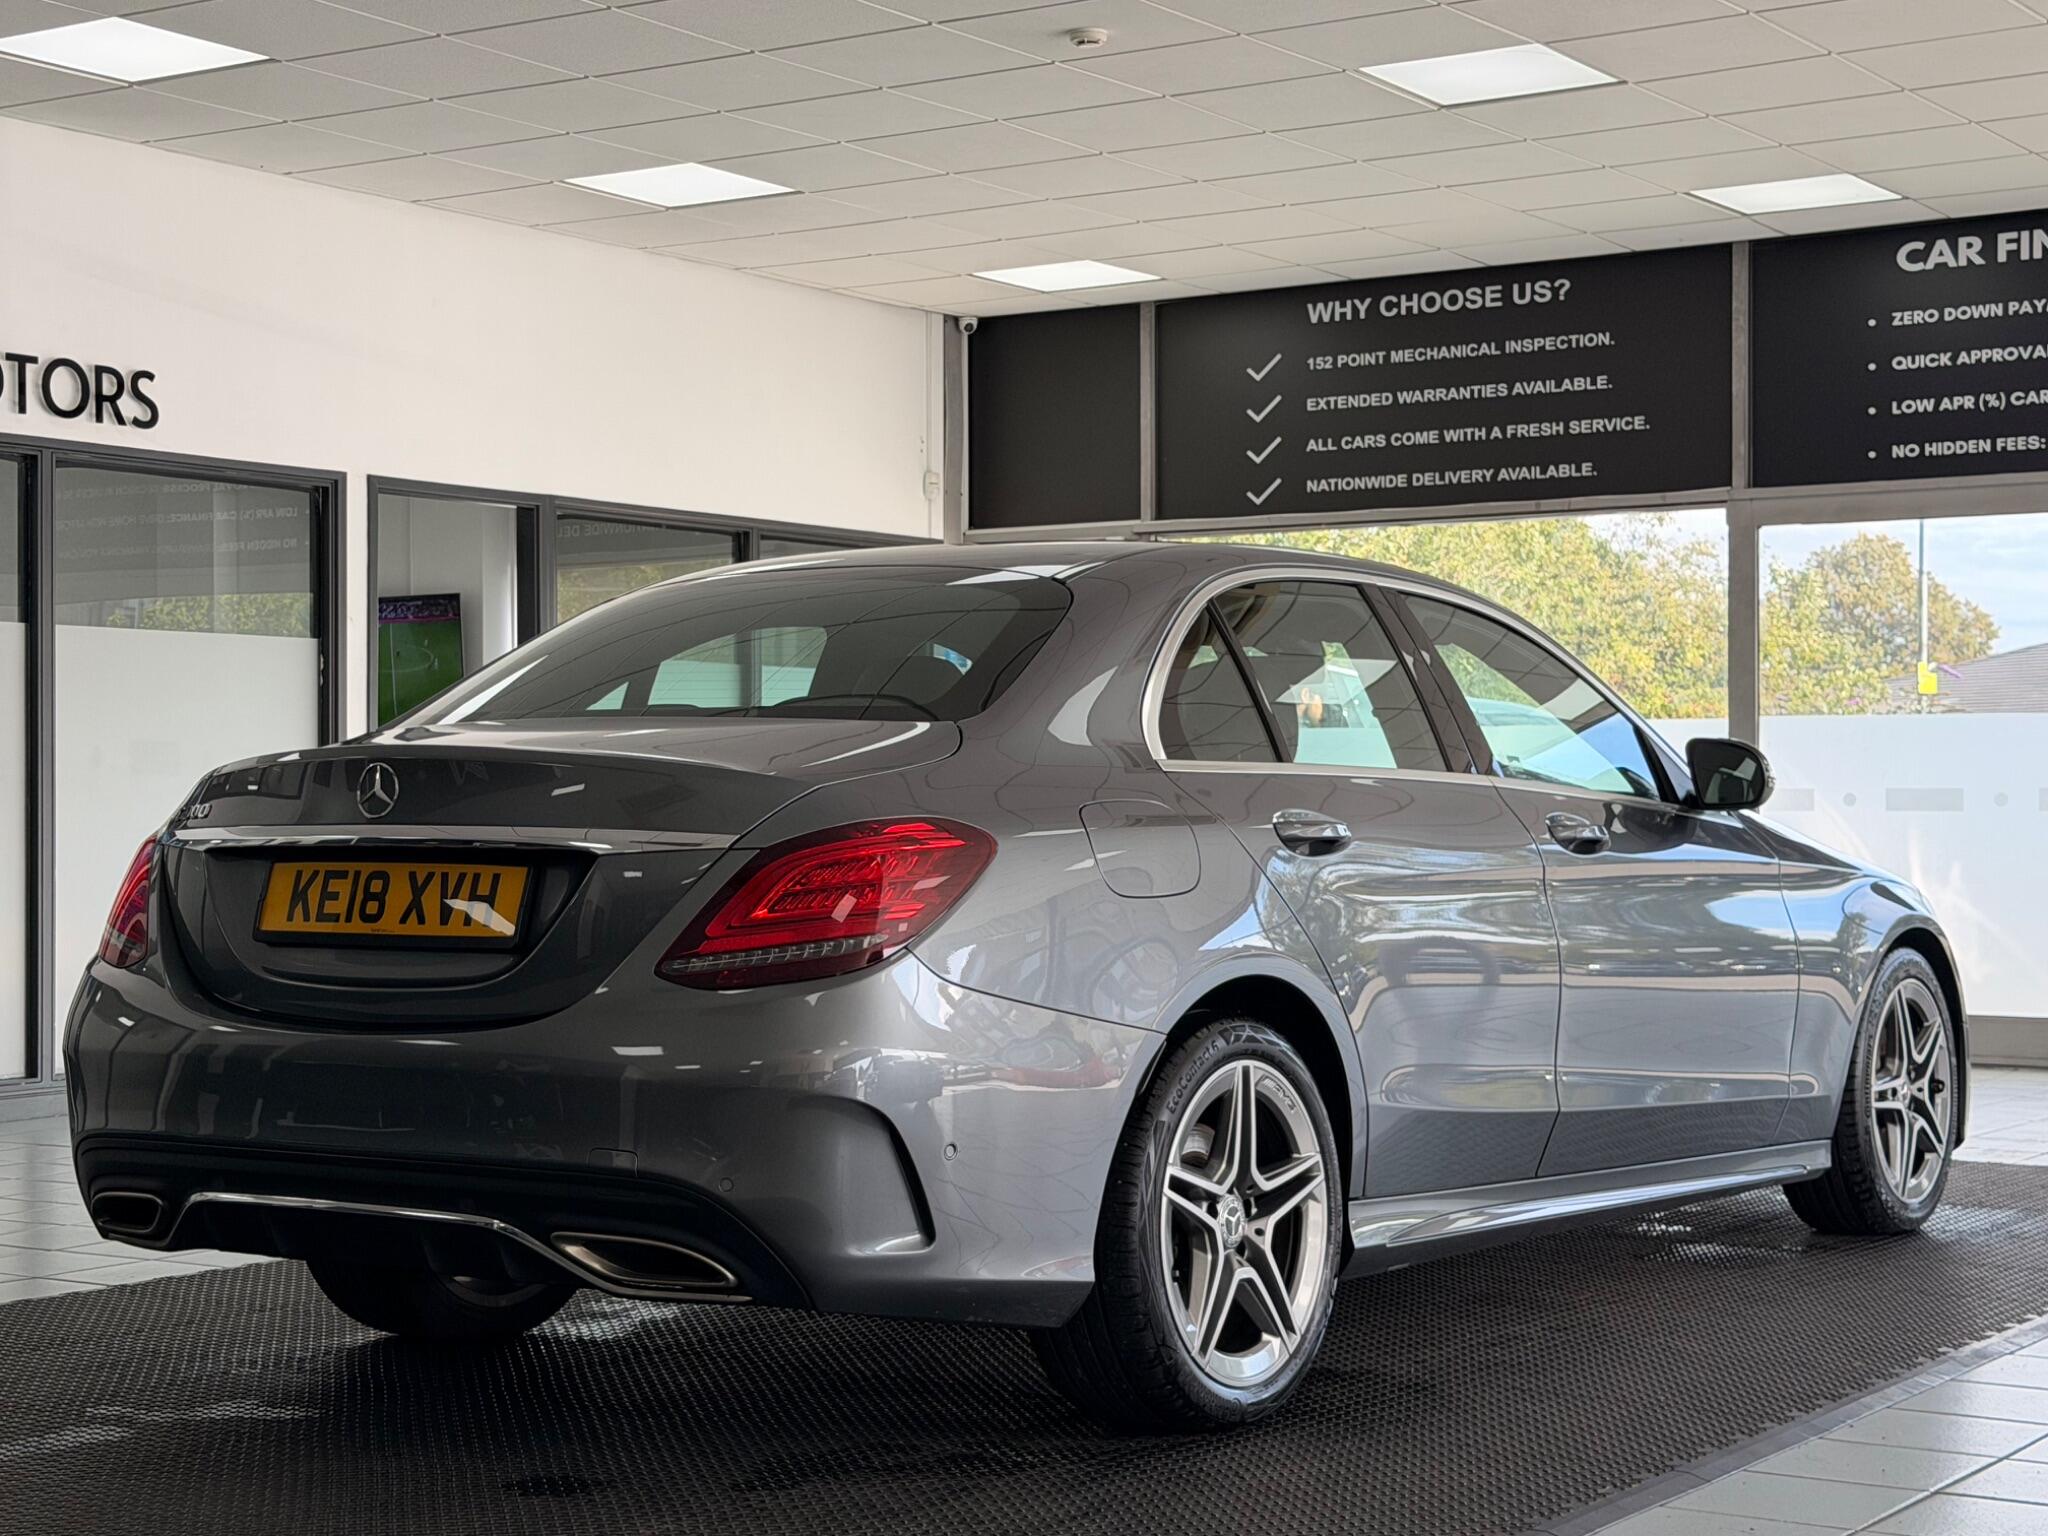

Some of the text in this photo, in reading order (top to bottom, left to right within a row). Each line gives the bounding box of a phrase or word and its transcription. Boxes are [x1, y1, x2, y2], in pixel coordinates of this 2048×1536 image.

[1896, 235, 1986, 272] CAR
[1307, 279, 1571, 324] WHY CHOOSE US?
[1891, 298, 2048, 326] ZERO DOWN PAY
[1307, 332, 1615, 371] 152 POINT MECHANICAL INSPECTION.
[1891, 344, 2048, 370] QUICK APPROVA
[0, 352, 159, 430] TORS
[1306, 375, 1613, 411] EXTENDED WARRANTIES AVAILABLE.
[1891, 389, 2048, 415] LOW APR (%) CAR
[1306, 415, 1650, 452] ALL CARS COME WITH A FRESH SERVICE.
[1891, 435, 2046, 459] NO HIDDEN FEES:
[1306, 462, 1597, 493] NATIONWIDE DELIVERY AVAILABLE.
[286, 869, 502, 928] KE18 XVH
